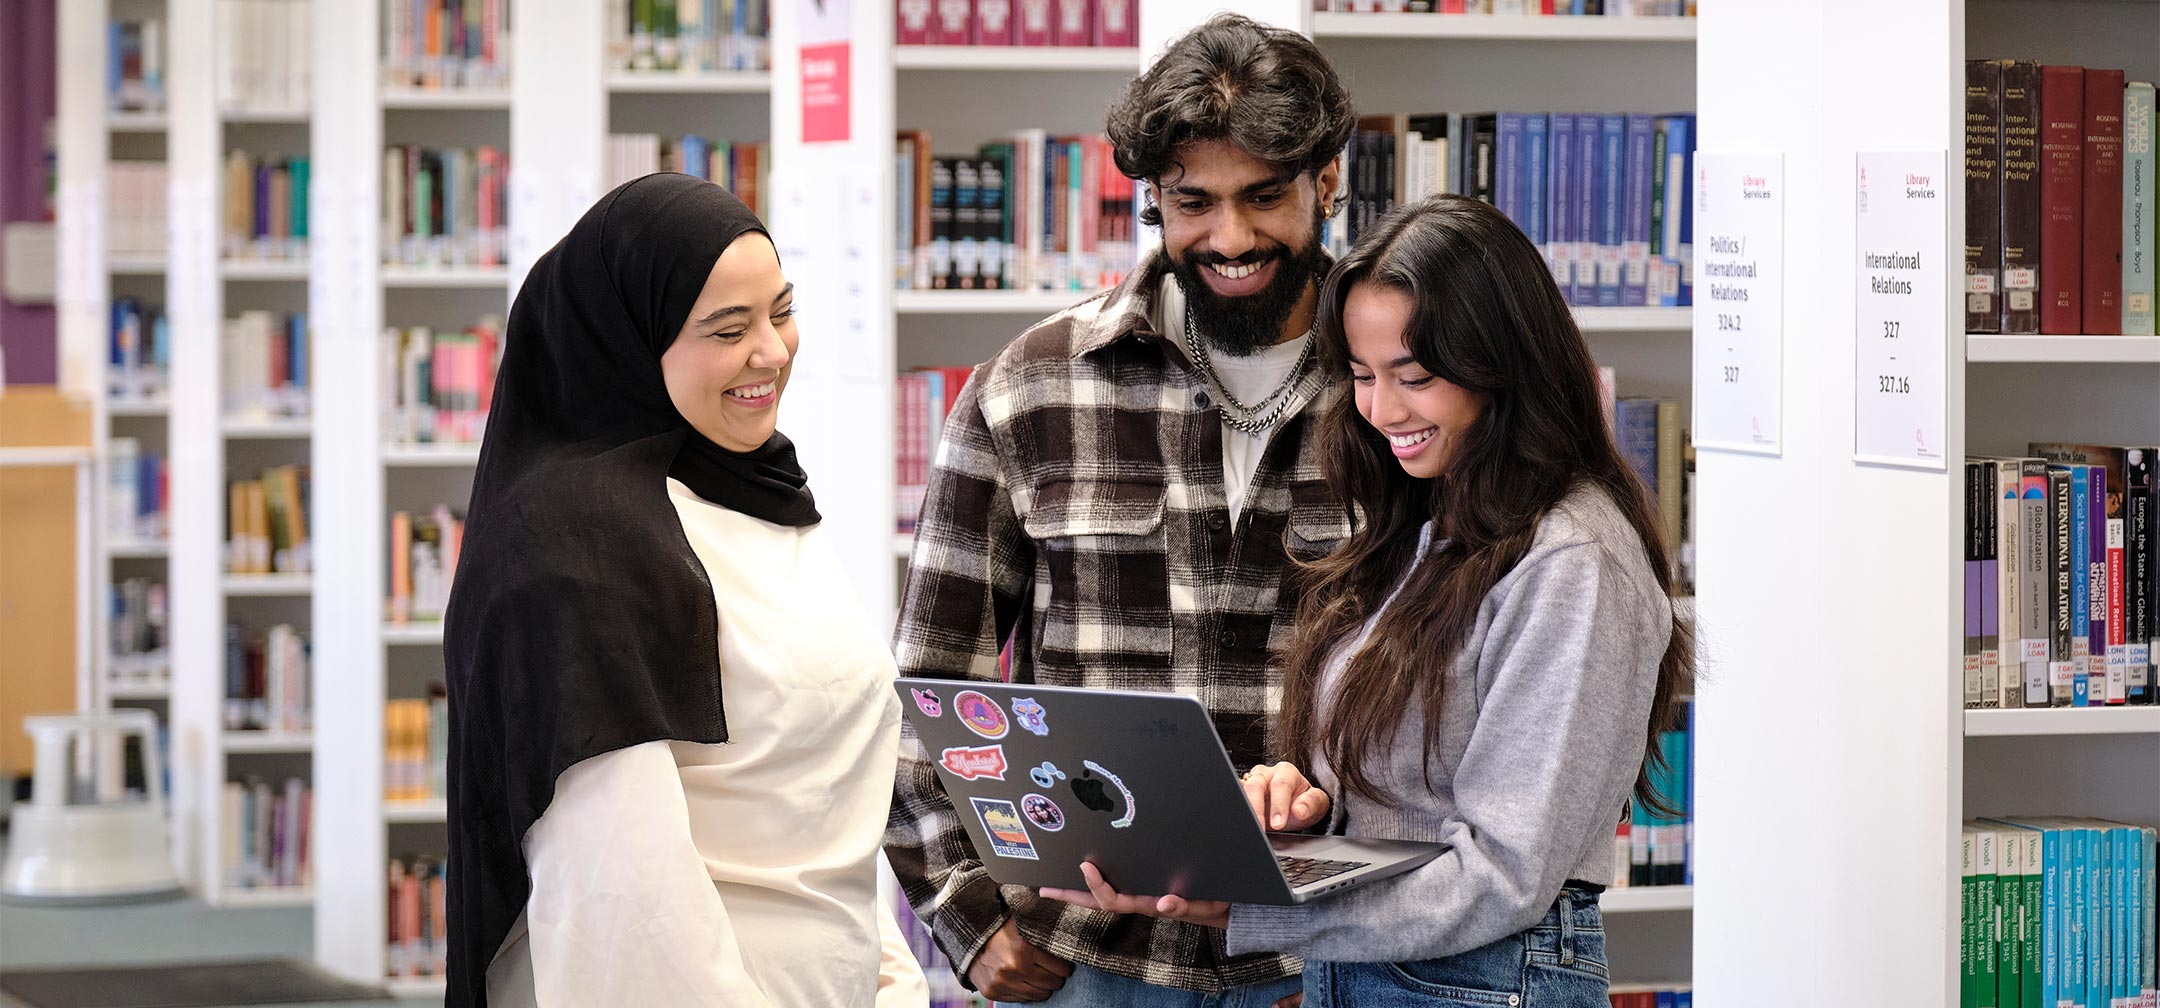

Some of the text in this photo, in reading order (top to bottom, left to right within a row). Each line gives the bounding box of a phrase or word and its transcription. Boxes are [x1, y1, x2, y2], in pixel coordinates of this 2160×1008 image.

[1967, 112, 1989, 121] Inter-
[2005, 114, 2028, 123] Inter-
[2128, 96, 2138, 153] POLITICS
[1967, 125, 1998, 133] national
[2005, 127, 2037, 135] national
[2139, 105, 2149, 153] WORLD
[1967, 135, 1996, 145] Politics
[2005, 137, 2034, 146] Politics
[1967, 147, 1982, 155] and
[2005, 149, 2021, 157] and
[1966, 157, 1997, 169] Foreign
[2005, 159, 2036, 170] Foreign
[1743, 175, 1765, 188] Library
[1906, 174, 1930, 187] Library
[1966, 169, 1991, 180] Policy
[2005, 171, 2030, 181] Policy
[1743, 188, 1771, 199] Services
[1906, 187, 1935, 199] Services
[2134, 203, 2142, 245] Thompson
[1710, 235, 1746, 257] Politics /
[1705, 260, 1757, 278] International
[1865, 250, 1921, 270] International
[2134, 252, 2142, 273] Boyd
[1710, 283, 1749, 302] Relations
[1871, 275, 1912, 295] Relations
[1718, 314, 1741, 331] 324.2
[1883, 321, 1900, 339] 327
[1724, 366, 1740, 383] 327
[1879, 375, 1910, 394] 327.16
[2061, 450, 2071, 461] the
[2072, 452, 2086, 462] State
[2077, 493, 2085, 519] Social
[2136, 496, 2146, 532] Europe,
[2058, 483, 2068, 568] INTERNATIONAL
[2035, 506, 2043, 572] Globalization
[2077, 521, 2085, 570] Movements
[2138, 534, 2146, 550] the
[2138, 552, 2146, 578] State
[2075, 571, 2085, 583] for
[2112, 552, 2120, 606] International
[2058, 571, 2069, 631] RELATIONS
[2077, 584, 2085, 614] Global
[2077, 615, 2085, 637] Dem
[2137, 598, 2146, 644] Globalisa
[995, 846, 1037, 858] PALESTINE
[2047, 866, 2055, 896] Theory
[2092, 868, 2100, 898] Theory
[2132, 868, 2140, 896] Theory
[2048, 897, 2055, 905] of
[2064, 900, 2071, 908] of
[2093, 899, 2099, 907] of
[2118, 898, 2125, 906] of
[2133, 898, 2140, 906] of
[1968, 882, 1976, 975] Explaining International
[1978, 880, 1986, 961] Relations Since 1945
[1986, 880, 1994, 973] Explaining International
[2011, 881, 2019, 974] Explaining International
[2034, 881, 2042, 973] Explaining International
[2075, 865, 2084, 984] Theory of International Politics
[2047, 957, 2055, 986] Politics
[2092, 959, 2100, 988] Politics
